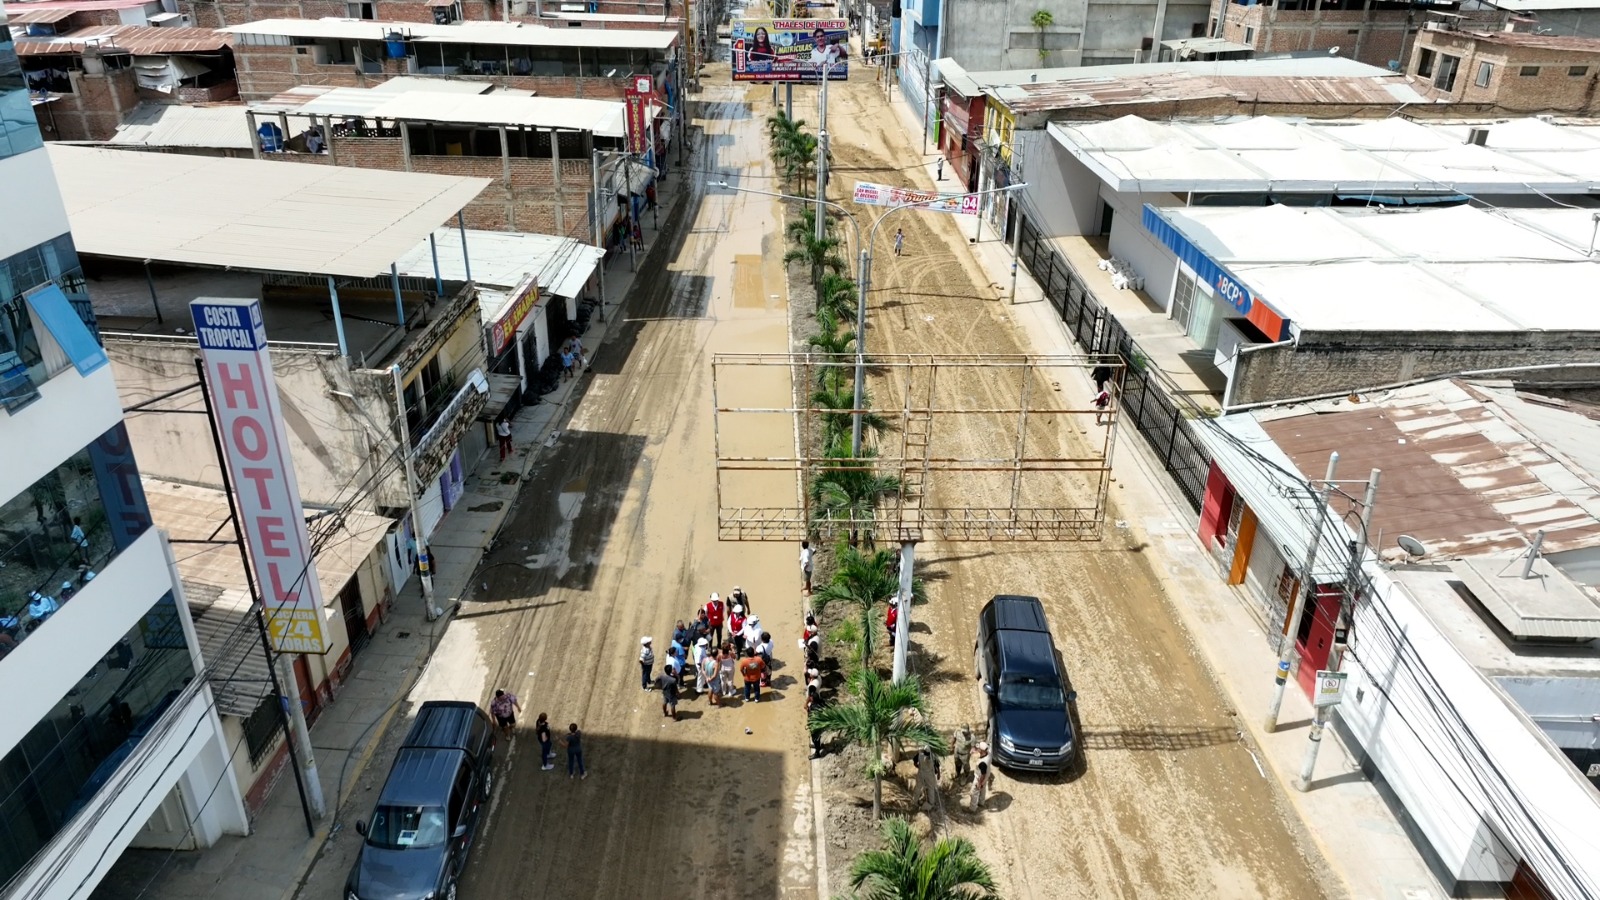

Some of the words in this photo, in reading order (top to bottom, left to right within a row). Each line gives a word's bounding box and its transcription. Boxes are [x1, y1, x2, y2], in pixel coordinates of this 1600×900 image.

[774, 20, 804, 30] THALES
[805, 20, 816, 30] DE
[817, 20, 846, 30] MILETO
[963, 197, 977, 209] 04
[1222, 278, 1240, 301] BCP
[203, 305, 241, 328] COSTA
[503, 319, 513, 338] EL
[200, 327, 254, 349] TROPICAL
[216, 362, 299, 602] HOTEL
[268, 610, 316, 620] COCHERA
[275, 621, 312, 637] 24
[274, 637, 321, 651] HORAS
